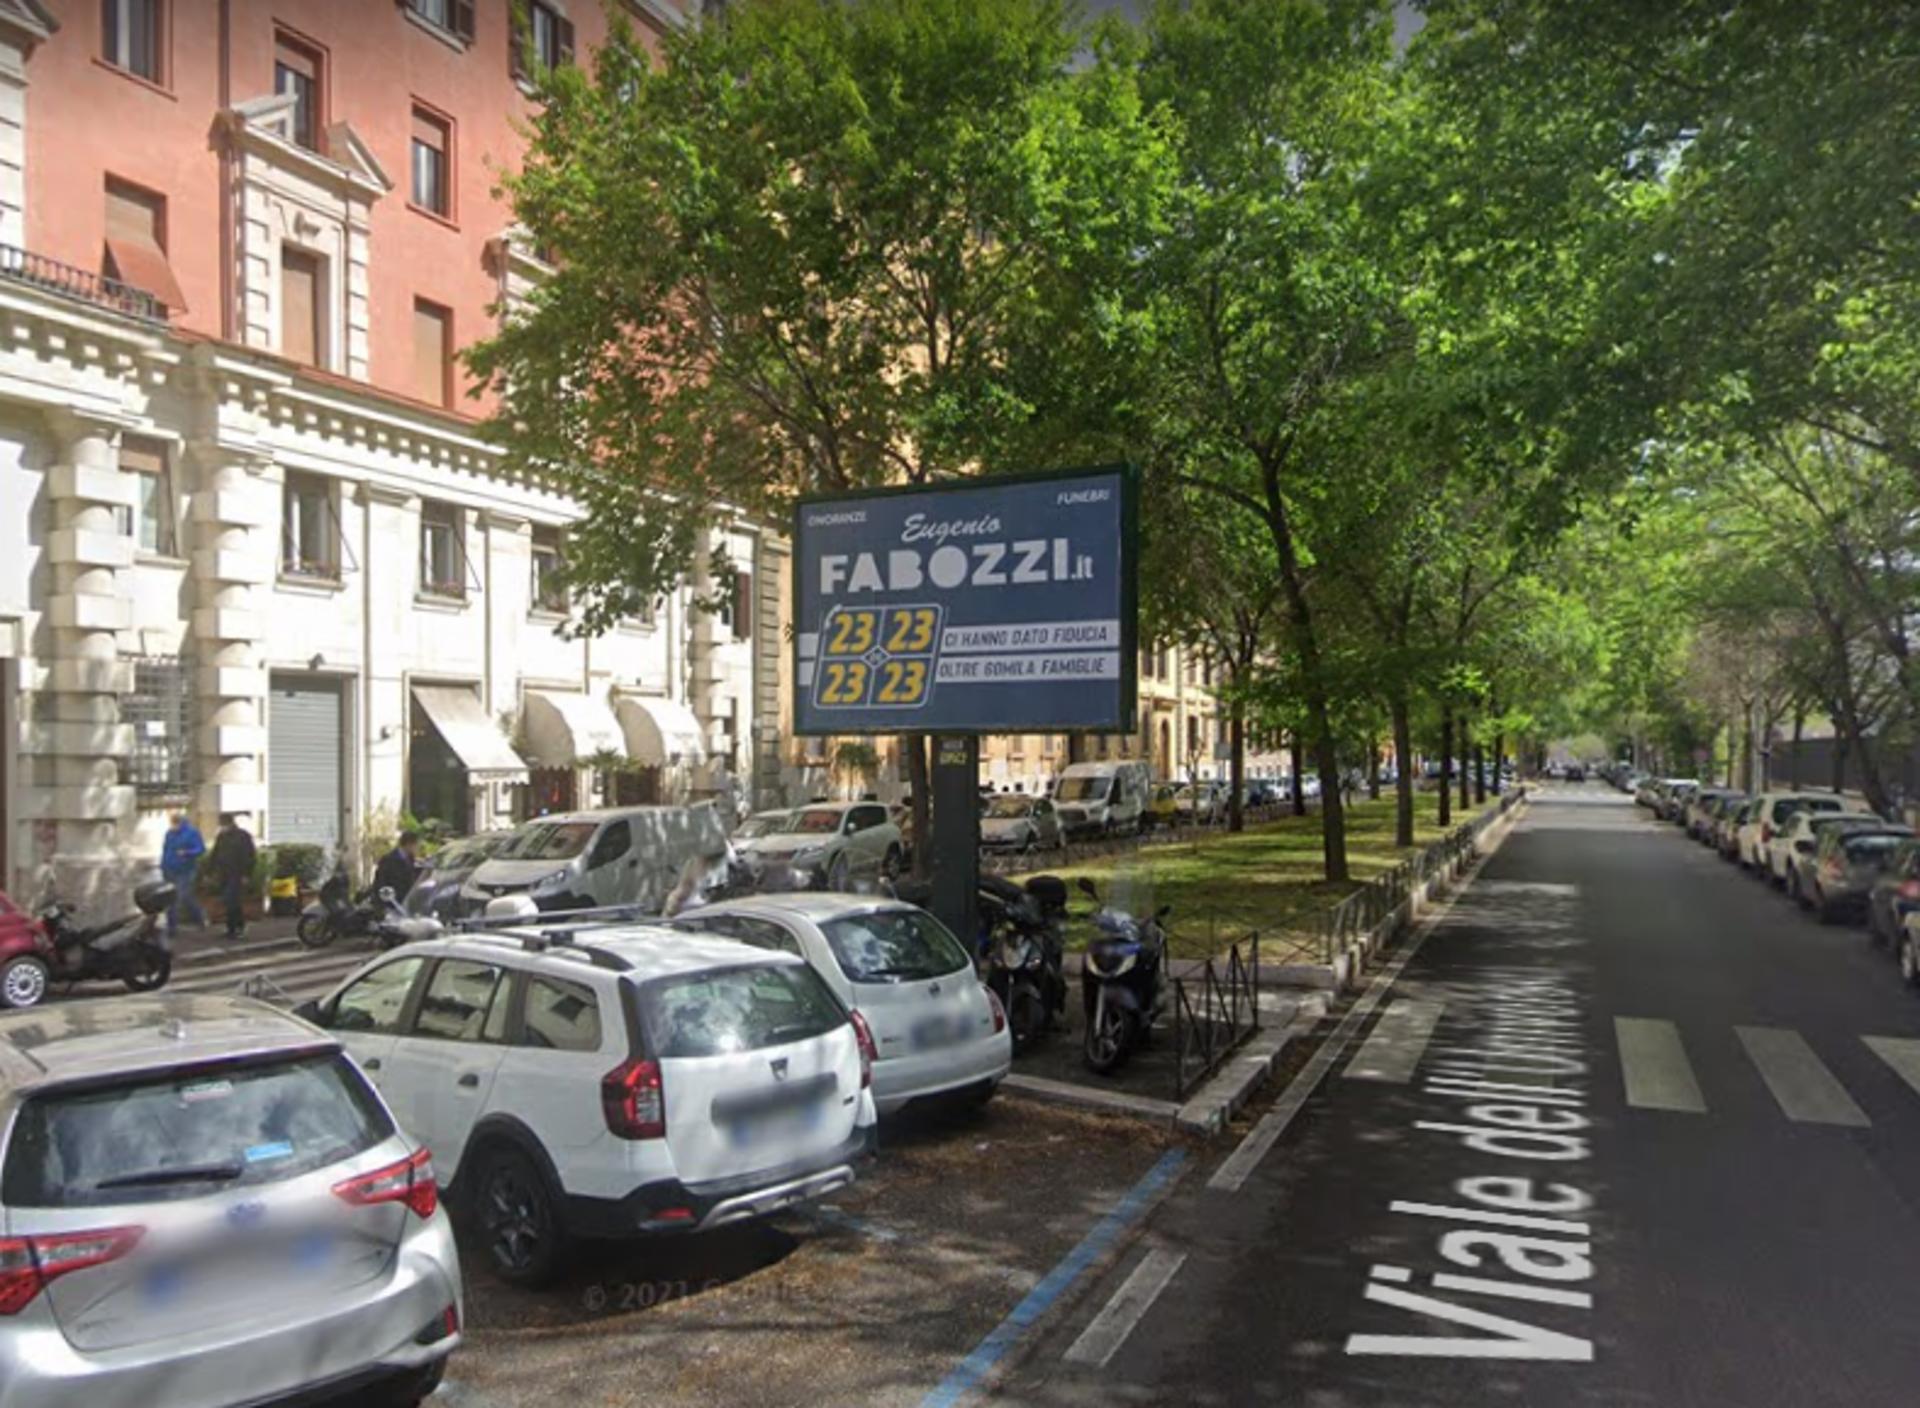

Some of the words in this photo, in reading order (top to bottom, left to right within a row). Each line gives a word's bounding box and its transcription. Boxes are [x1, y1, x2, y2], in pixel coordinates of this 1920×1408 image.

[900, 513, 1002, 545] Eugenio
[820, 537, 1094, 594] FABOZZI.it
[829, 611, 876, 653] 23
[886, 608, 935, 651] 23
[945, 632, 959, 648] CI
[962, 630, 1009, 647] HANNO
[1011, 628, 1048, 644] DATO
[1053, 625, 1107, 643] FIDUCIA
[821, 662, 867, 703] 23
[877, 661, 926, 702] 23
[940, 661, 979, 678] OLTRE
[1041, 657, 1105, 675] FAMIGLIE
[1343, 1174, 1594, 1361] Viale
